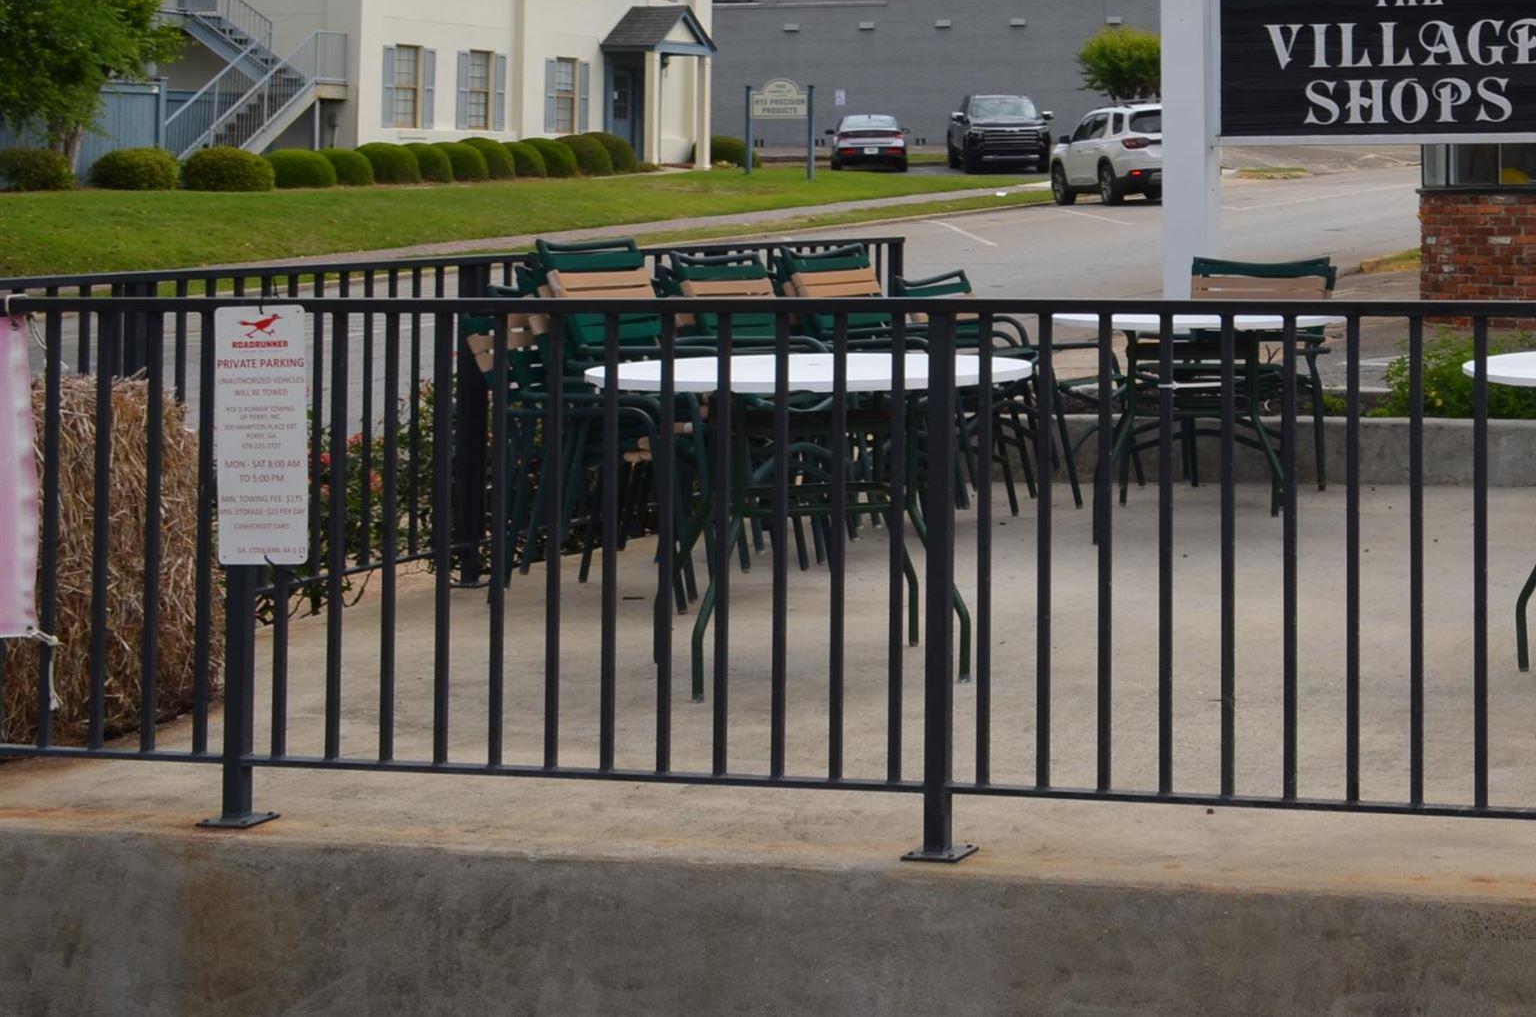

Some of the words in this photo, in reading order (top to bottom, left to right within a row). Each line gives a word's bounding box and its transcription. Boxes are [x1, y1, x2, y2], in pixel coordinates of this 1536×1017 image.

[1303, 77, 1513, 125] SHOPS
[232, 341, 288, 349] ROADRUNNER
[217, 359, 257, 369] PRIVATE
[260, 358, 305, 368] PARKING
[224, 460, 245, 468] MON
[252, 460, 265, 468] SAT
[268, 460, 285, 468] 8:00
[287, 460, 301, 468] AM
[240, 474, 250, 482] TO
[252, 474, 269, 482] 5:00
